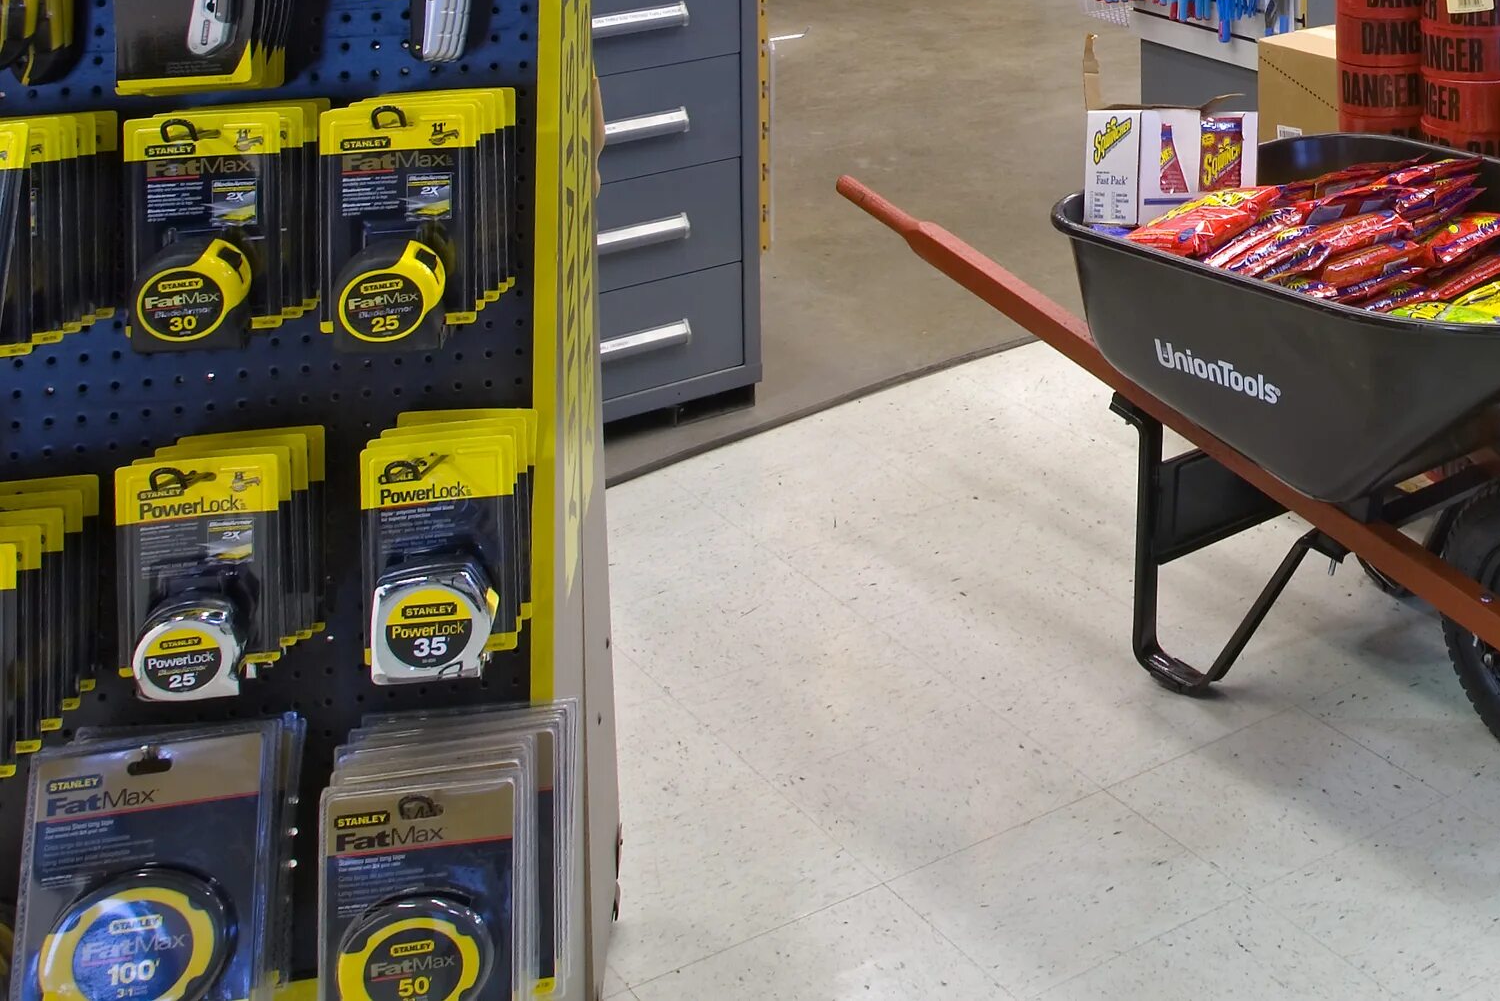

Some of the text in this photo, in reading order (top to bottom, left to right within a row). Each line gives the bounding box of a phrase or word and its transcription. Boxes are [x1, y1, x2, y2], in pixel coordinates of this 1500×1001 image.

[1341, 70, 1421, 107] DANGER
[147, 144, 194, 155] STANLEY
[343, 138, 388, 149] STANLEY
[341, 149, 446, 172] FatMax
[1096, 174, 1127, 186] Fast Pack
[160, 280, 200, 290] STANLEY
[363, 281, 401, 292] STANLEY
[145, 290, 220, 310] FatMax
[348, 291, 418, 310] FatMax
[1154, 337, 1278, 405] UnionTools
[380, 481, 467, 505] PowerLock
[139, 495, 241, 520] PowerLock
[405, 604, 455, 617] STANLEY
[391, 620, 466, 639] PowerLock
[161, 637, 200, 649] STANLEY
[147, 651, 215, 670] PowerLock
[49, 777, 100, 792] STANLEY
[46, 787, 155, 817] FatMax
[337, 813, 388, 828] STANLEY
[335, 825, 444, 853] FatMax
[392, 942, 432, 955] STANLEY
[370, 953, 456, 979] FatMax
